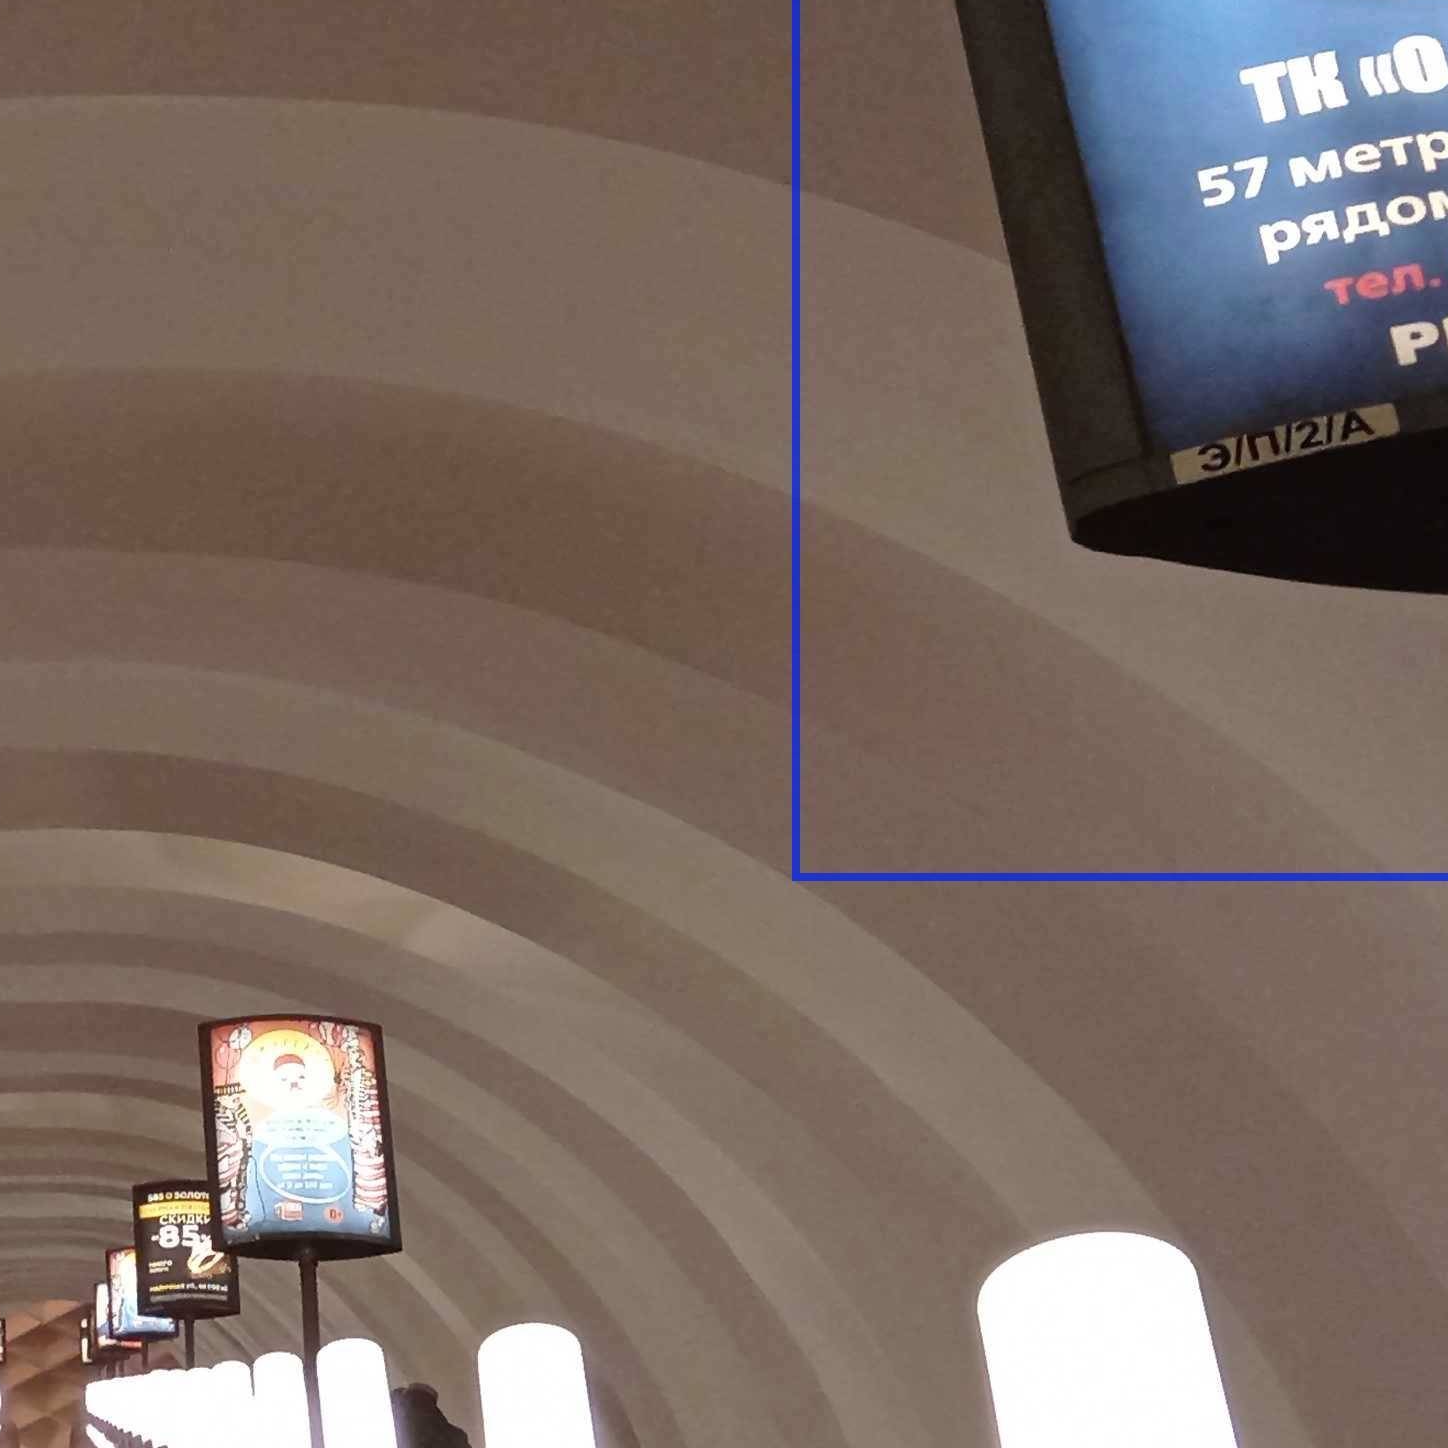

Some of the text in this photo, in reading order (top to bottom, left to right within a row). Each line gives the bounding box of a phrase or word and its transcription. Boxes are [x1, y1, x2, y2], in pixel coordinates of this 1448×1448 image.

[1239, 50, 1350, 125] ТК
[1196, 155, 1270, 208] 57
[1323, 263, 1442, 306] тел.
[1197, 410, 1376, 472] Э/П/2/А
